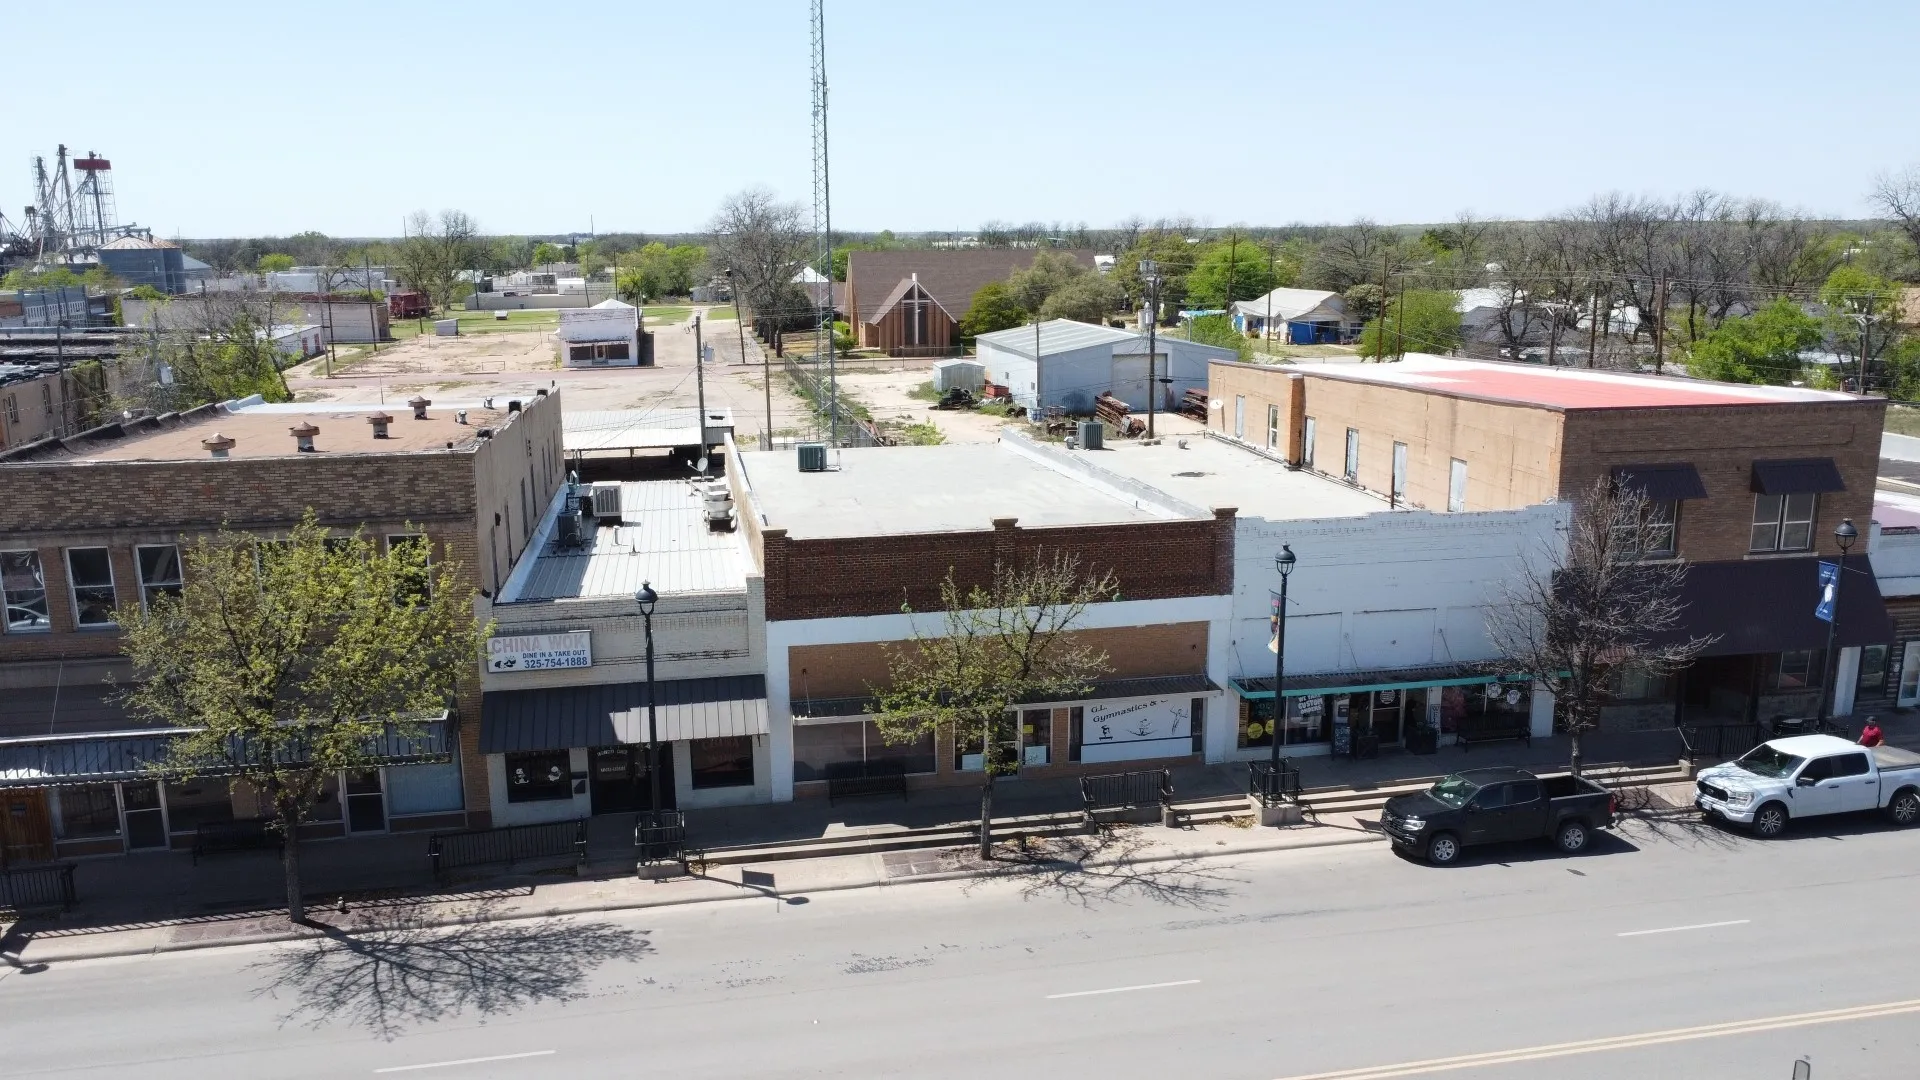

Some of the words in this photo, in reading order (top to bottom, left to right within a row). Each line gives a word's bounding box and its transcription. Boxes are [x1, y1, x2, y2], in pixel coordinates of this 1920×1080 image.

[492, 636, 542, 654] CHINA
[548, 634, 585, 650] WOK
[524, 656, 588, 669] 325-754-1888
[1298, 697, 1323, 710] CUSTOM
[1093, 703, 1148, 723] Gymnastics
